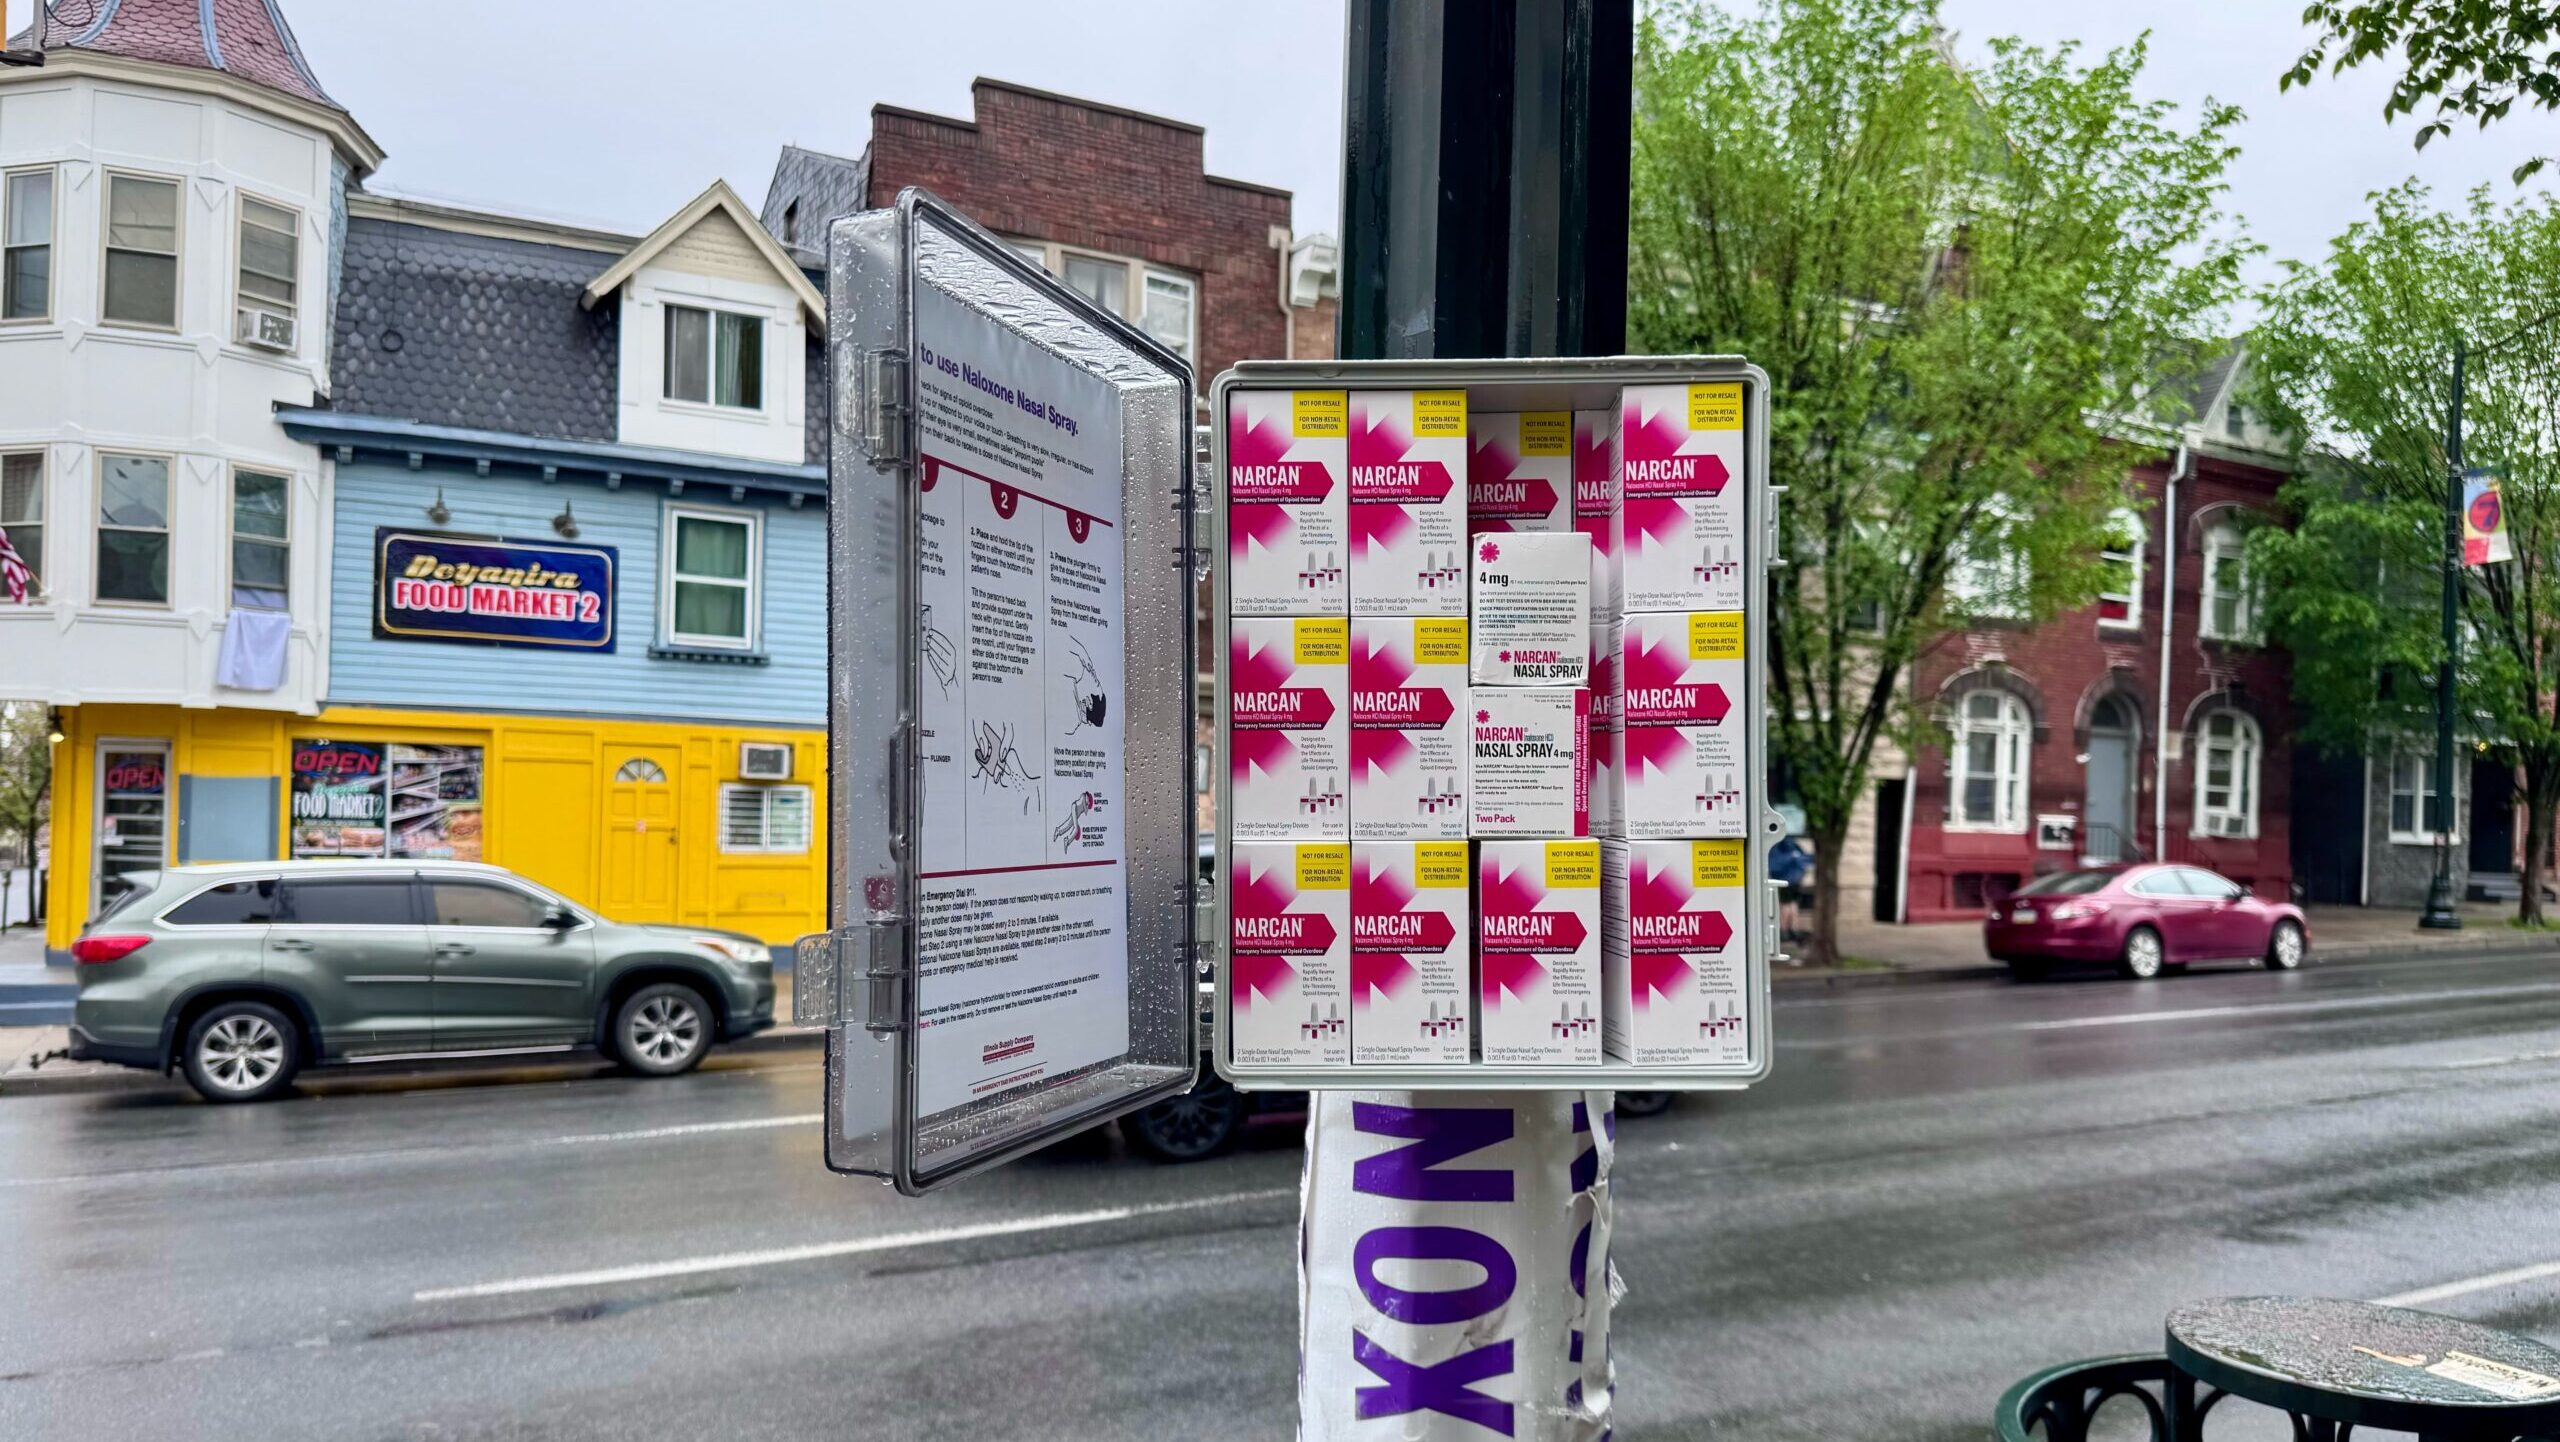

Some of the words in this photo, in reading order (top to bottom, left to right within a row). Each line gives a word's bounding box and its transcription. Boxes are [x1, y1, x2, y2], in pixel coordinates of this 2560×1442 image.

[920, 342, 933, 366] to
[937, 353, 959, 378] use
[962, 361, 1014, 405] Naloxone
[1017, 389, 1046, 420] Nasal
[1048, 404, 1079, 437] Spray.
[1001, 491, 1008, 510] 2
[1075, 517, 1083, 535] 3
[976, 527, 989, 540] Place
[989, 531, 999, 543] and
[1479, 572, 1487, 585] 4
[1489, 574, 1509, 588] mg
[393, 578, 467, 613] FOOD
[469, 583, 580, 622] MARKET
[579, 590, 601, 623] 2
[1513, 664, 1548, 678] NASAL
[1549, 664, 1583, 678] SPRAY
[1475, 743, 1514, 758] NASAL
[1516, 743, 1554, 758] SPRAY
[1553, 749, 1559, 758] 4
[1560, 751, 1574, 760] mg
[294, 749, 381, 775] OPEN
[293, 790, 327, 818] FOOD
[328, 793, 375, 819] MARKET
[1475, 813, 1493, 823] Two
[1494, 813, 1516, 823] Pack
[926, 889, 956, 902] Emergency
[956, 888, 966, 898] Dial
[966, 887, 977, 897] 911.
[999, 1039, 1014, 1049] Supply
[1014, 1034, 1034, 1045] Company
